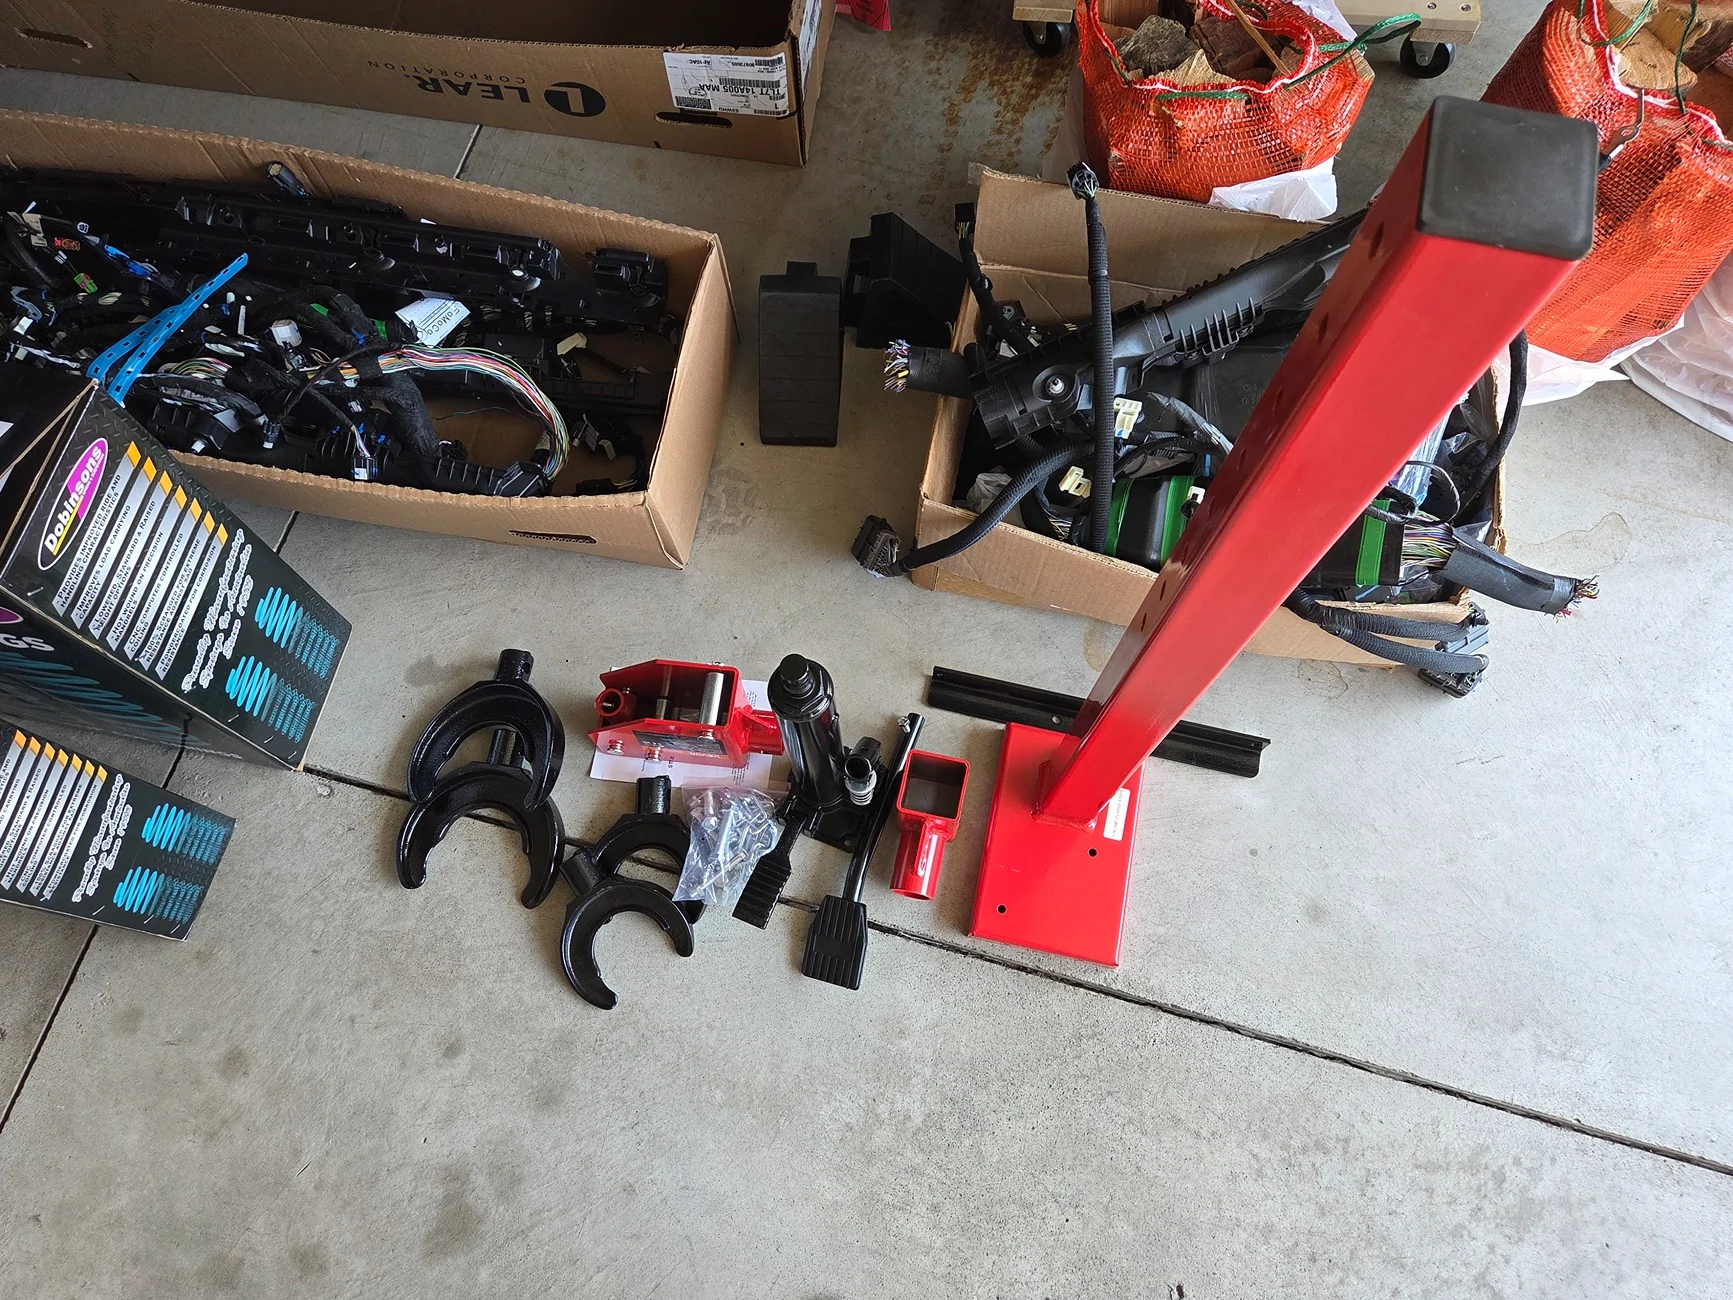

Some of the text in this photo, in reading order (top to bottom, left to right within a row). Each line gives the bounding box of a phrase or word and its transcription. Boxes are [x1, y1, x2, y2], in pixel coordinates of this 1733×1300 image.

[368, 60, 525, 84] CORPORATION
[414, 75, 531, 103] LEAR
[699, 84, 720, 92] MAA
[723, 85, 755, 94] 14A005
[44, 446, 102, 550] Dobinsons
[57, 473, 121, 599] PROVIDES IMPROVED RIDE AND
[59, 490, 120, 608] HANDLING CHARACTERISTICS
[76, 503, 131, 611] IMPROVES LOAD CARRYING
[94, 579, 119, 623] LOWERED,
[115, 537, 139, 580] STANDARD
[138, 499, 156, 529] RAISED
[112, 530, 164, 634] HOT WOUND ON PRECISION
[155, 588, 178, 632] SCRAGGED
[175, 575, 184, 589] FOR
[180, 537, 201, 576] EXTREME
[78, 580, 101, 620] CAPACITY
[96, 565, 131, 631] HEIGHT OPTIONS
[128, 532, 184, 645] CNC COMPUTER CONTROLLED
[160, 544, 217, 665] POWDERCOATED FOR CORROSION
[114, 598, 138, 642] MANDRELS
[130, 620, 149, 653] COILING
[146, 566, 193, 663] RESISTANCE AGAINST SAG
[162, 626, 186, 673] RESISTANCE
[1, 758, 11, 772] AND
[1, 777, 20, 812] CARRYING
[8, 800, 28, 836] STANDARD
[27, 767, 42, 792] RAISED
[65, 783, 82, 816] EXTREME
[76, 783, 97, 823] CORROSION
[5, 788, 49, 878] HOT WOUND ON PRECISION
[5, 823, 22, 852] OPTIONS
[20, 784, 68, 881] CNC COMPUTER CONTROLLED
[7, 846, 28, 883] MANDRELS
[22, 859, 38, 887] COILING
